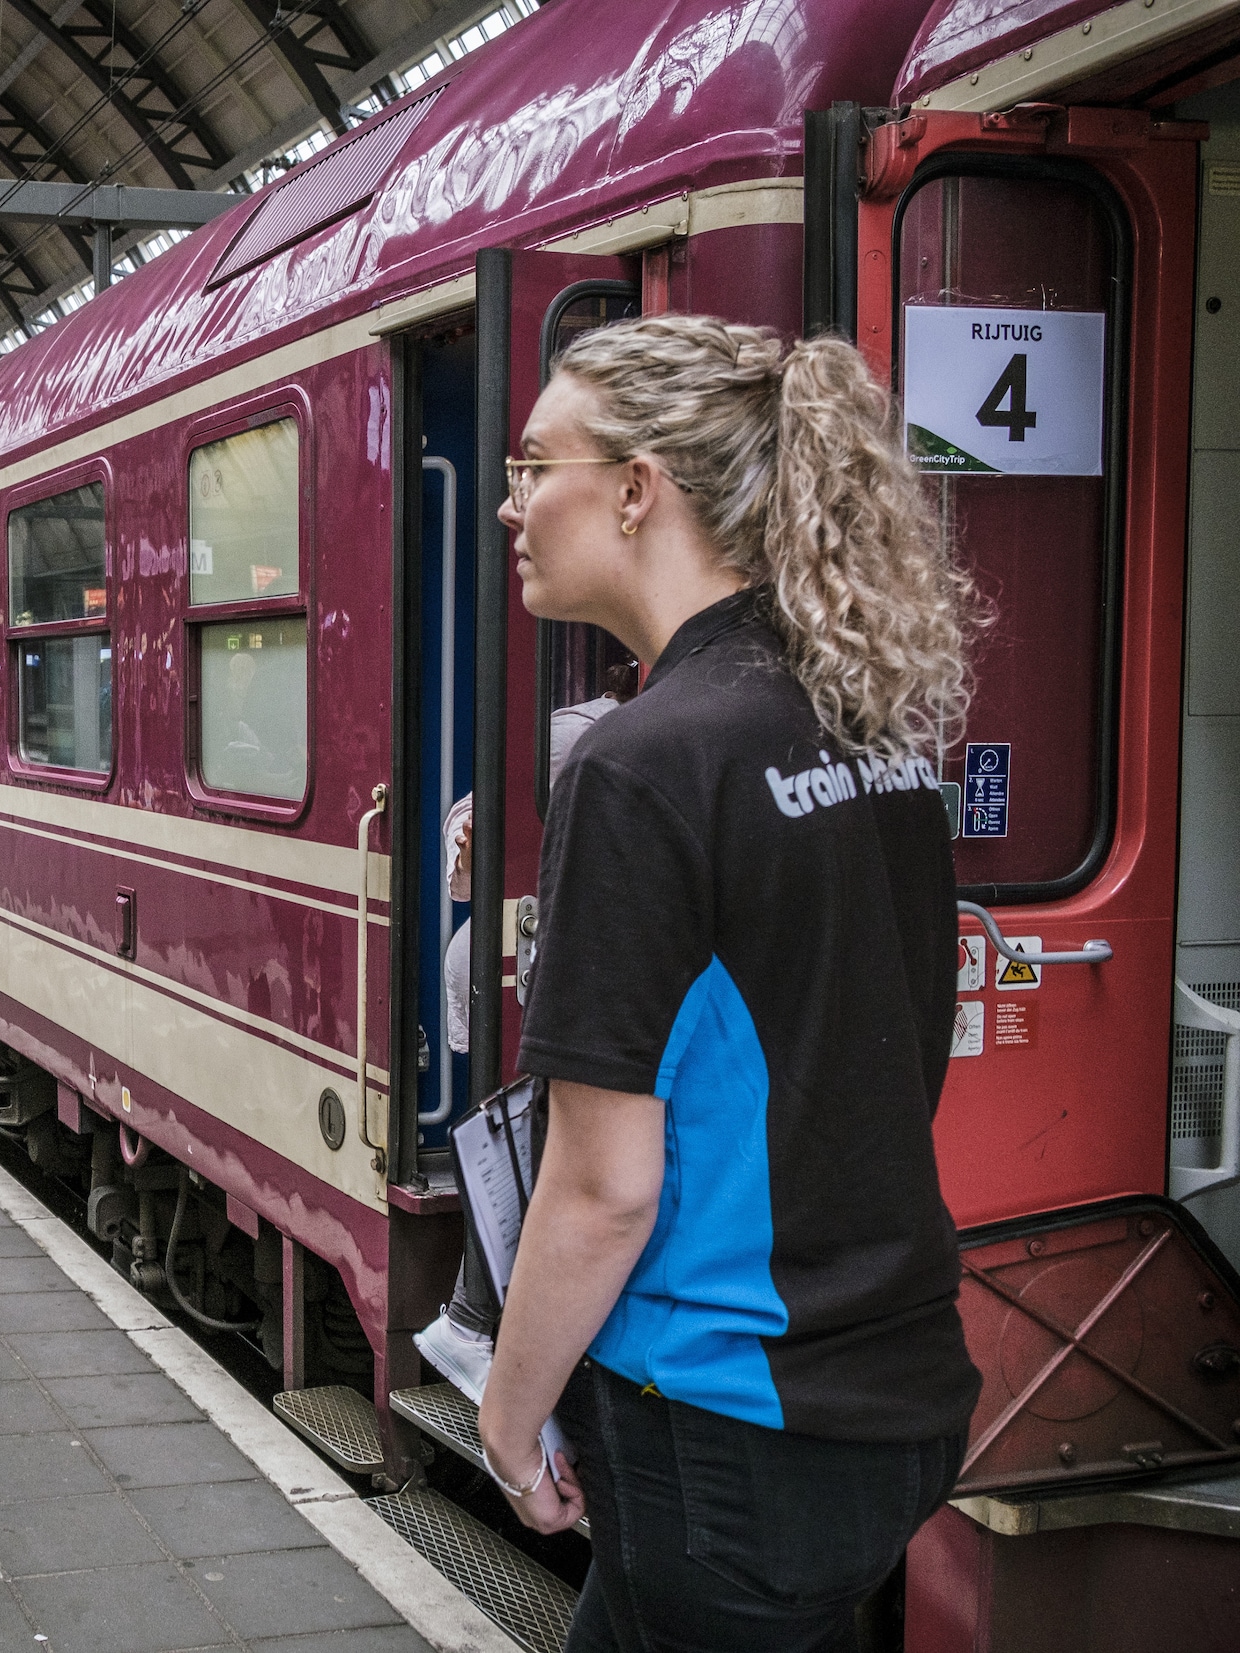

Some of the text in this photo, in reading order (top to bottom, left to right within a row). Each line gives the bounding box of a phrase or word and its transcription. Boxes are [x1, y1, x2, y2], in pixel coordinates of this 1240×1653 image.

[971, 323, 1043, 342] RIJTUIG
[975, 353, 1037, 442] 4
[909, 454, 966, 465] GreenCityTrip
[764, 749, 858, 818] train
